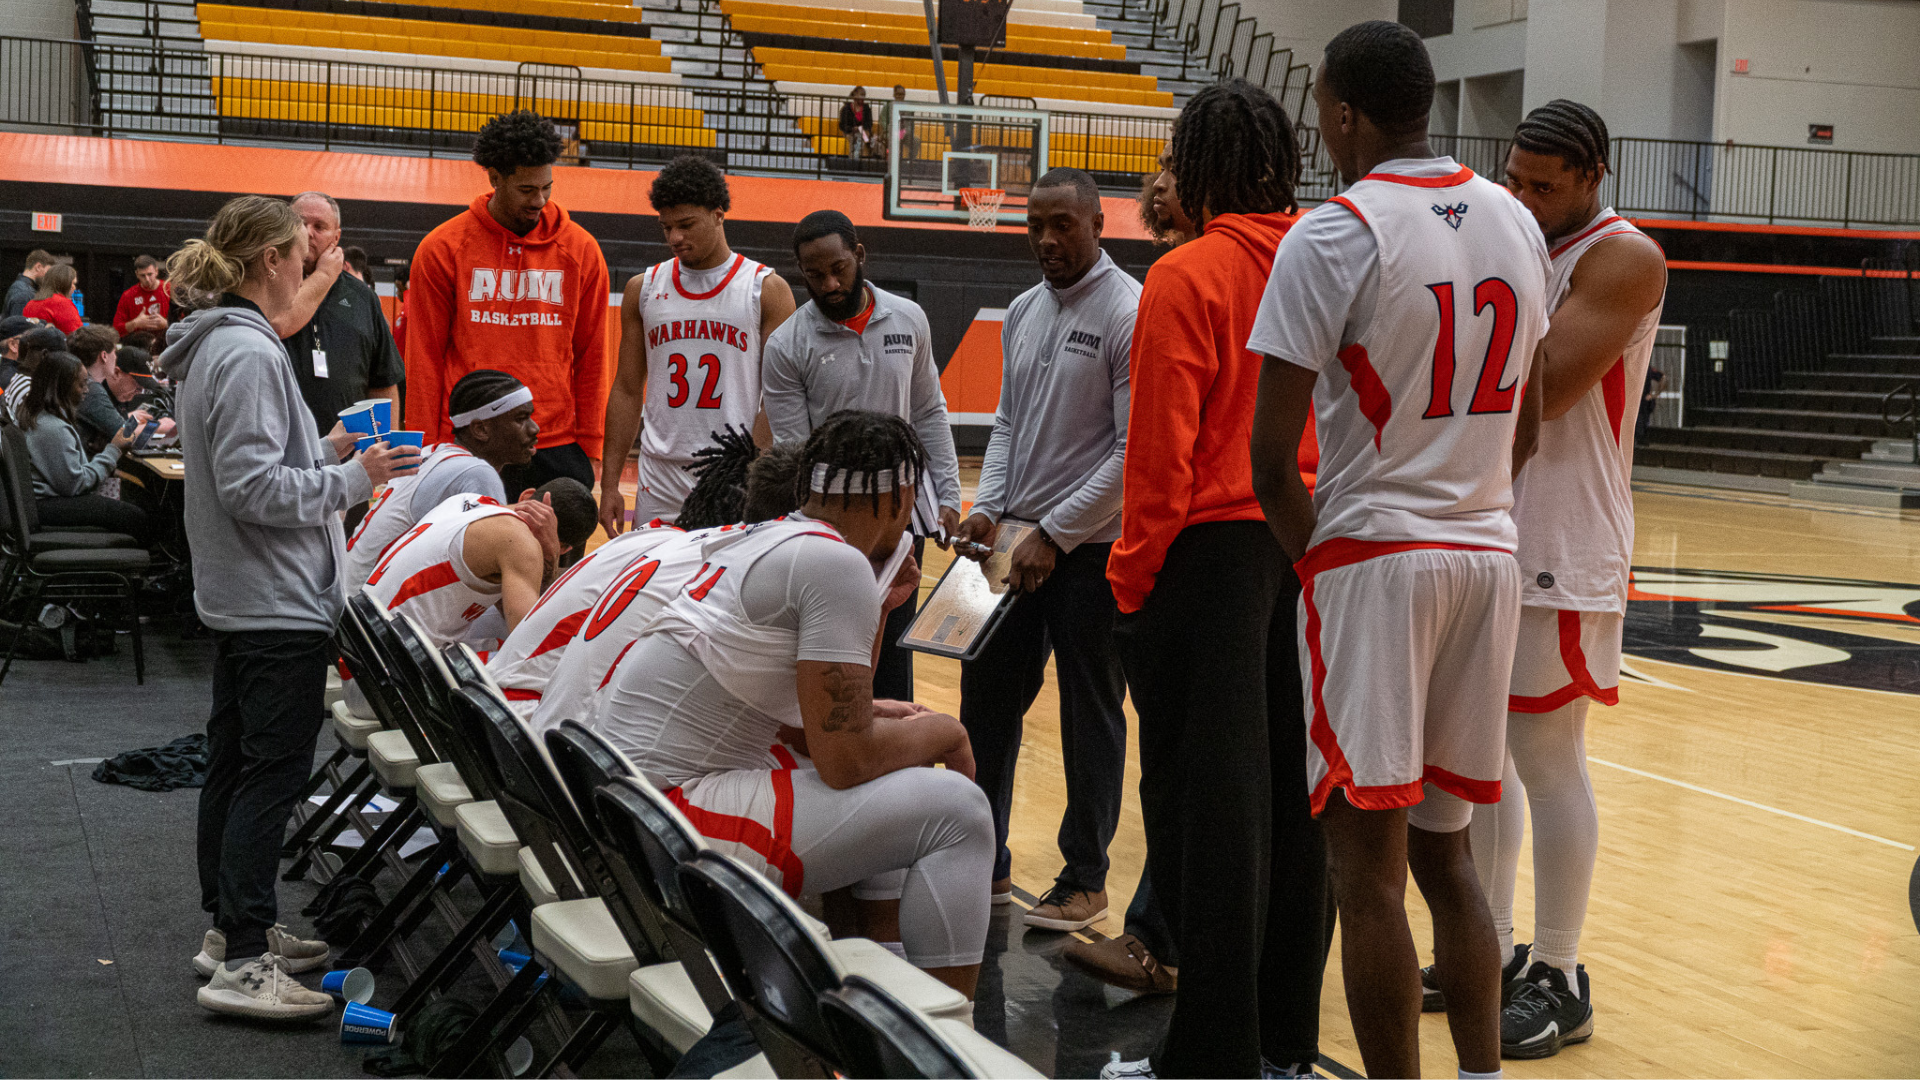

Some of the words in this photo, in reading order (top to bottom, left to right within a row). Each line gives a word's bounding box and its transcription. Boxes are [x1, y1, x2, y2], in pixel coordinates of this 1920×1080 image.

[37, 214, 58, 231] EXIT
[468, 267, 564, 306] AUM
[470, 309, 562, 326] BASKETBALL
[648, 319, 748, 352] WARHAWKS
[883, 334, 913, 347] AUM
[1067, 330, 1102, 350] AUM
[1064, 345, 1097, 359] BASKETBALL
[1421, 277, 1519, 419] 12
[667, 352, 723, 409] 32
[344, 1025, 387, 1036] POWERADE
